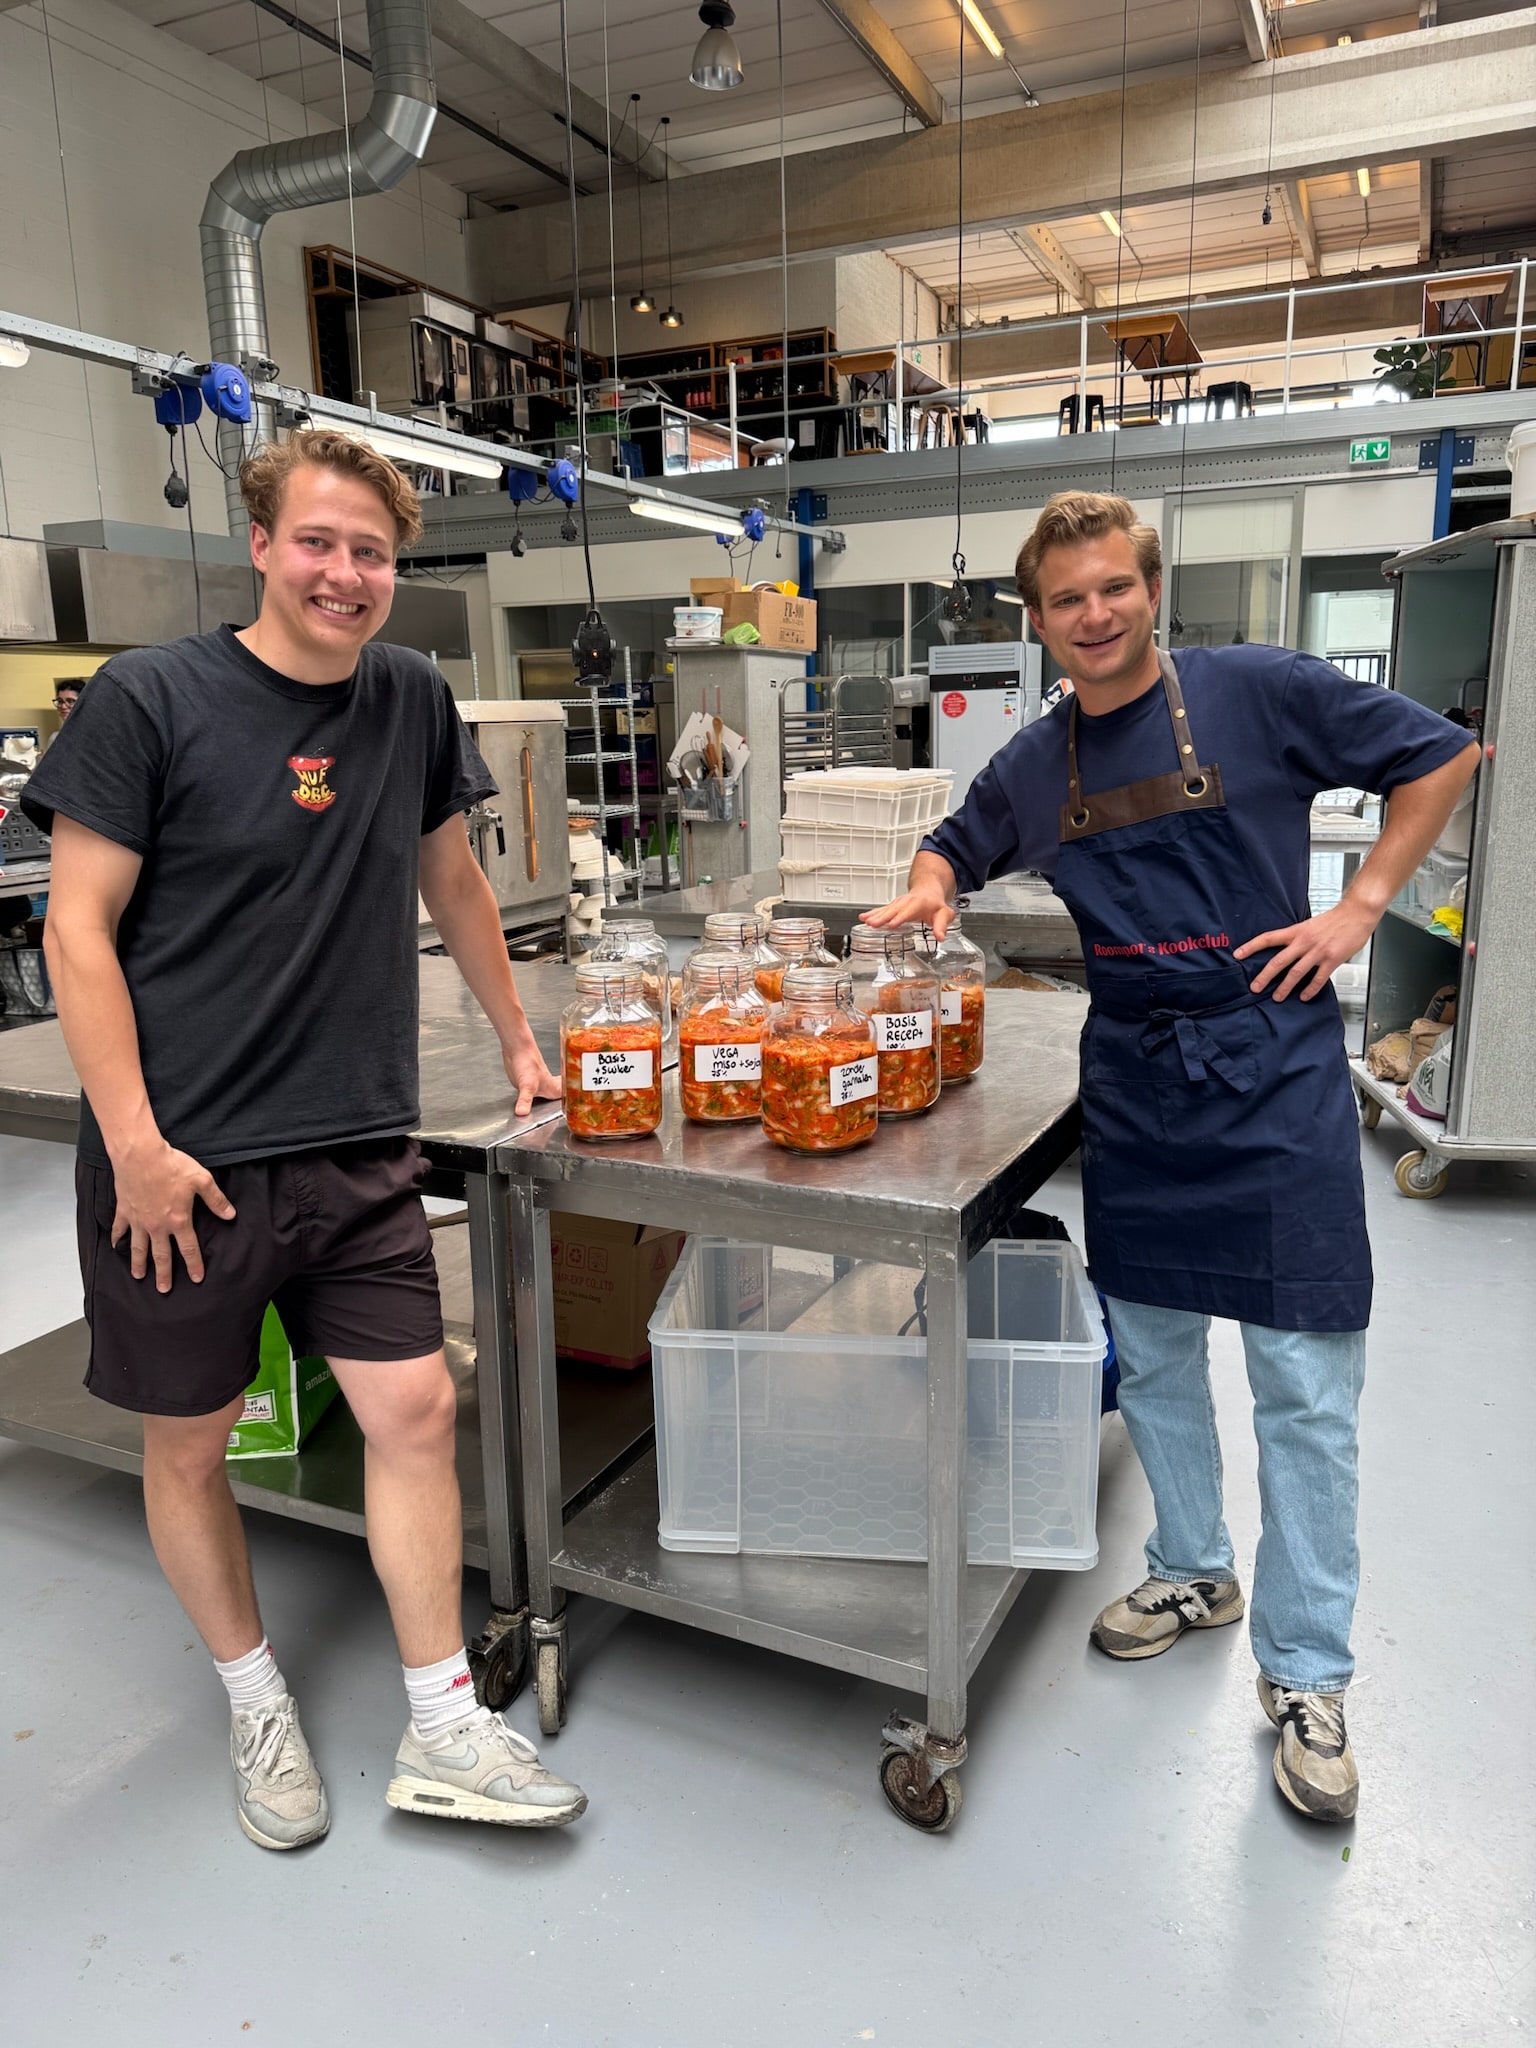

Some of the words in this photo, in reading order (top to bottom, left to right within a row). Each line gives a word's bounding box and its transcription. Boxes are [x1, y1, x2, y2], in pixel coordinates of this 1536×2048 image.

[1158, 932, 1230, 955] Kookclub
[886, 1015, 917, 1029] Basis
[598, 1053, 626, 1065] Basis
[713, 1060, 737, 1070] miso
[711, 1069, 728, 1078] 75%
[592, 1076, 610, 1086] 75%
